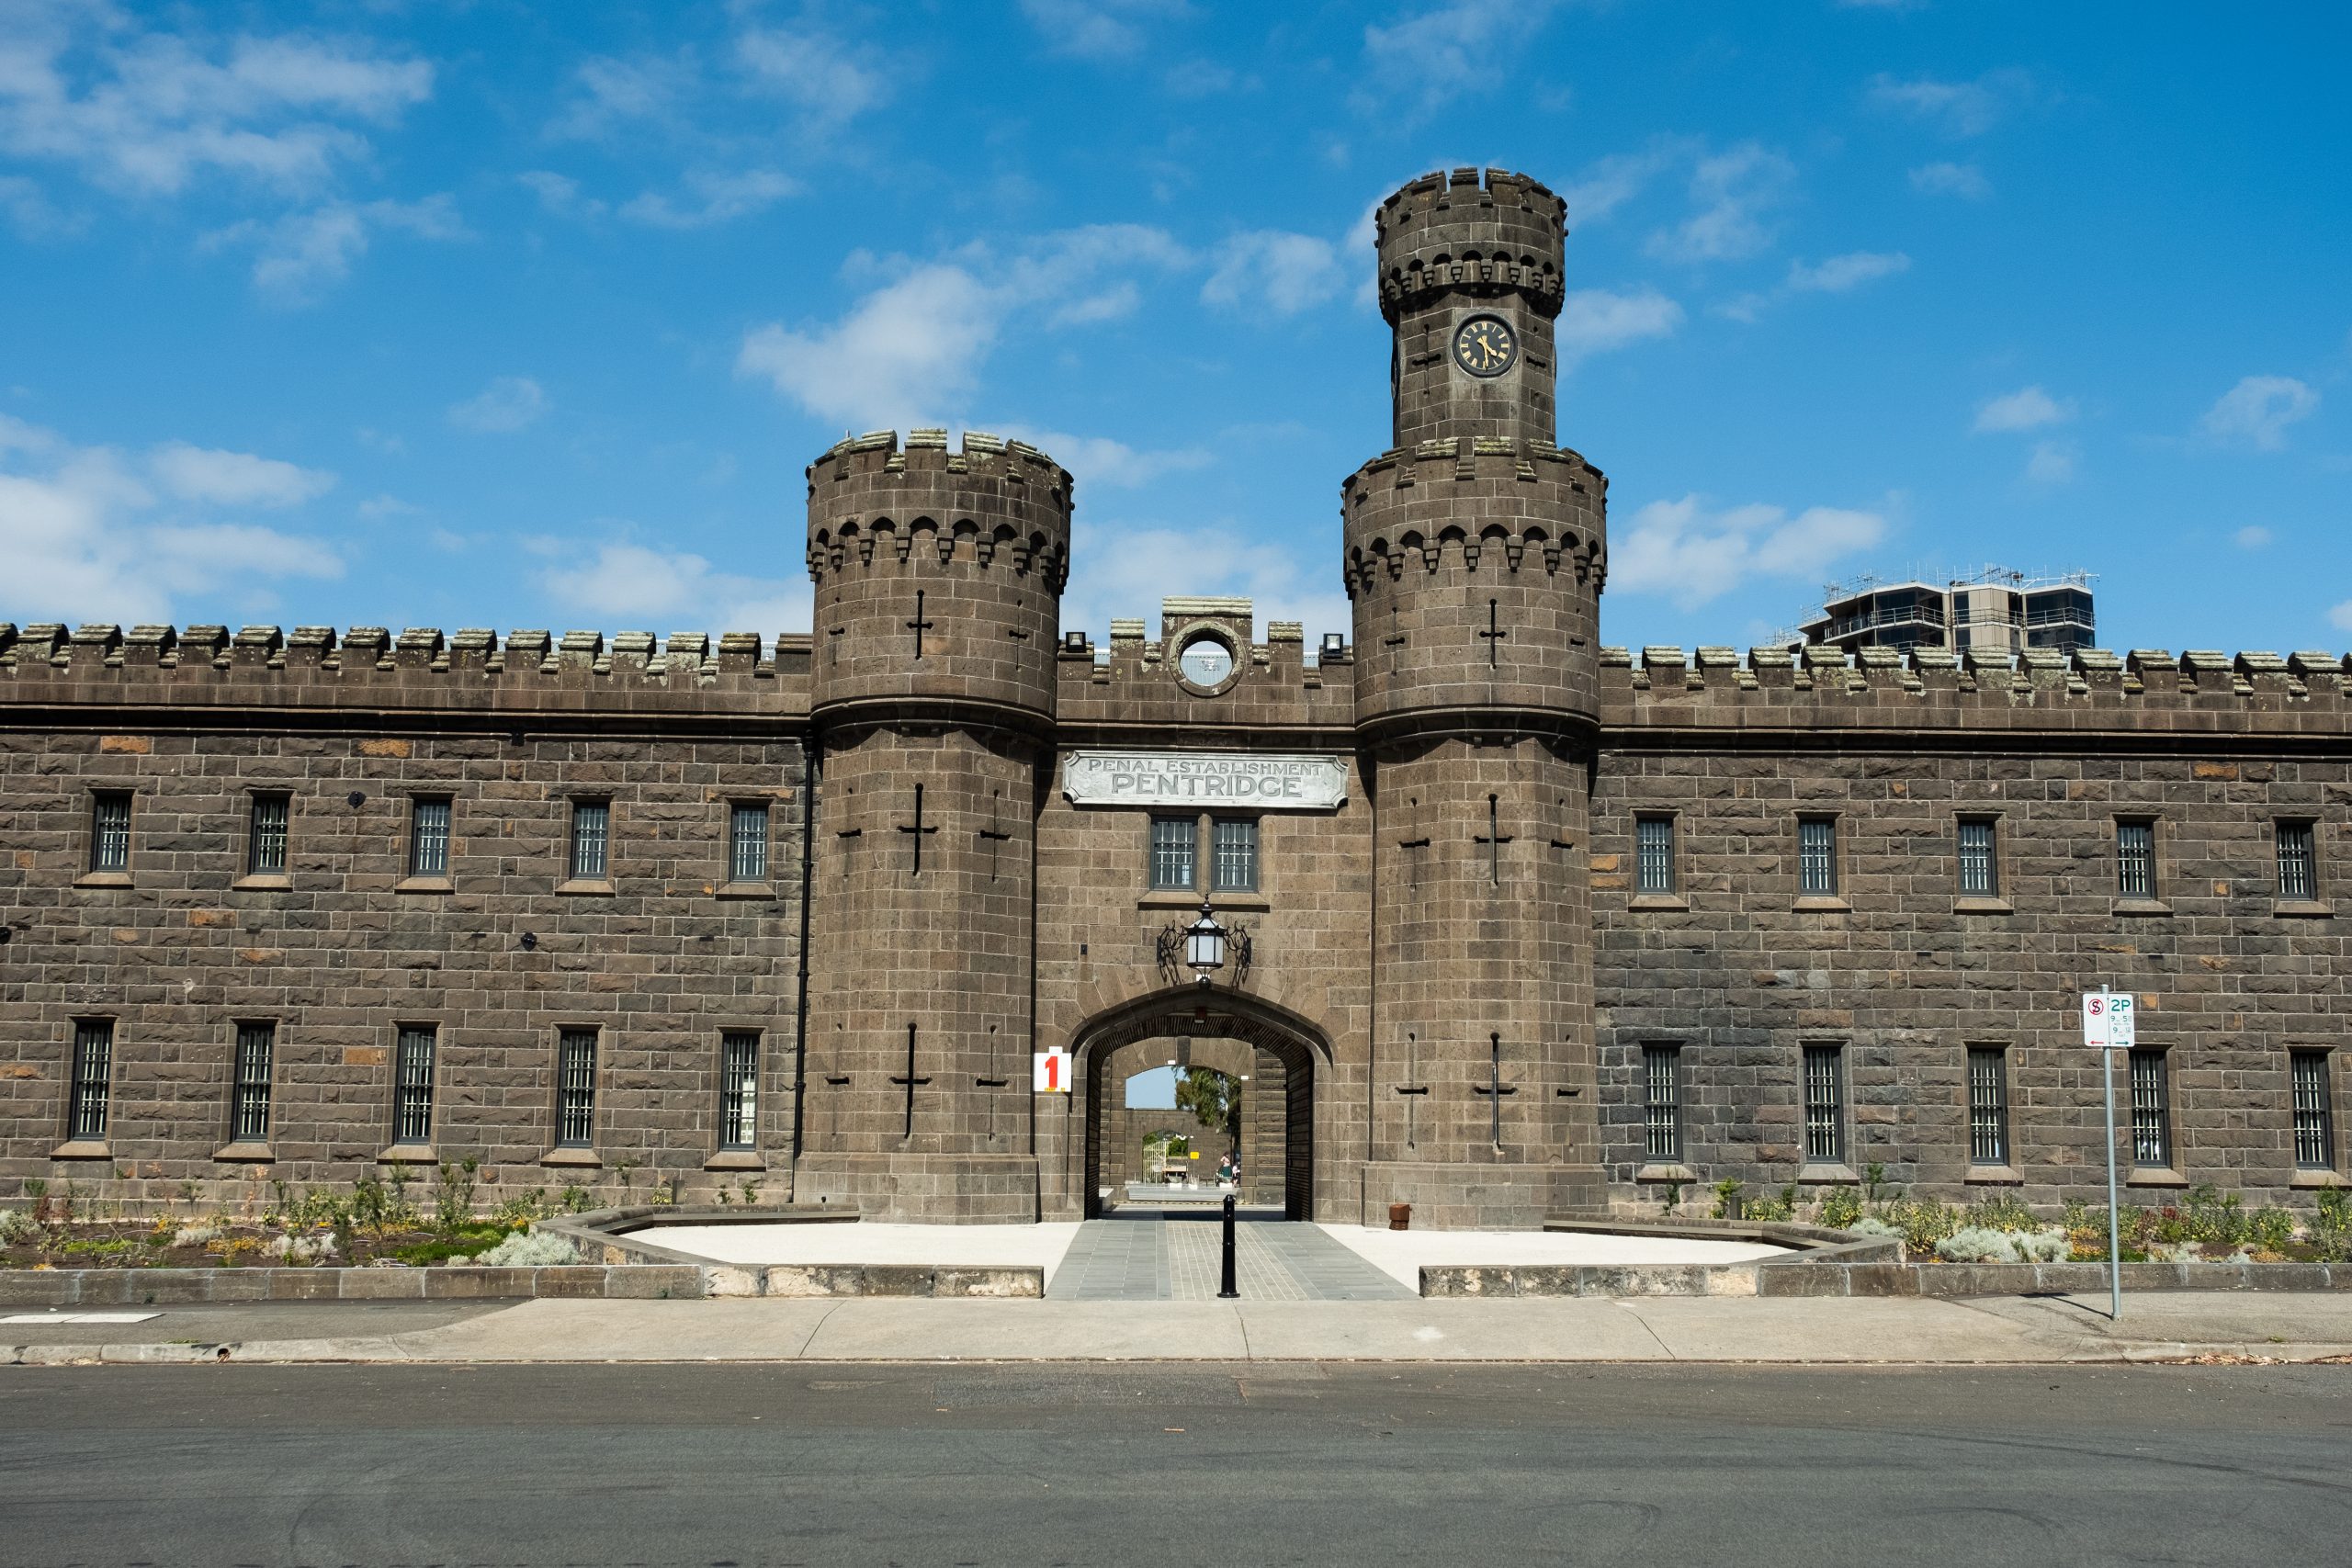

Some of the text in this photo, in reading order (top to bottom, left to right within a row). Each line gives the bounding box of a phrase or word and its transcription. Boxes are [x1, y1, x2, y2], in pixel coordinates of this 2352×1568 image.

[1088, 758, 1324, 776] PENAL ESTABLISHMENT
[1111, 773, 1303, 798] PENTRIDGE
[2110, 998, 2130, 1011] 2P
[1045, 1056, 1058, 1089] 1
